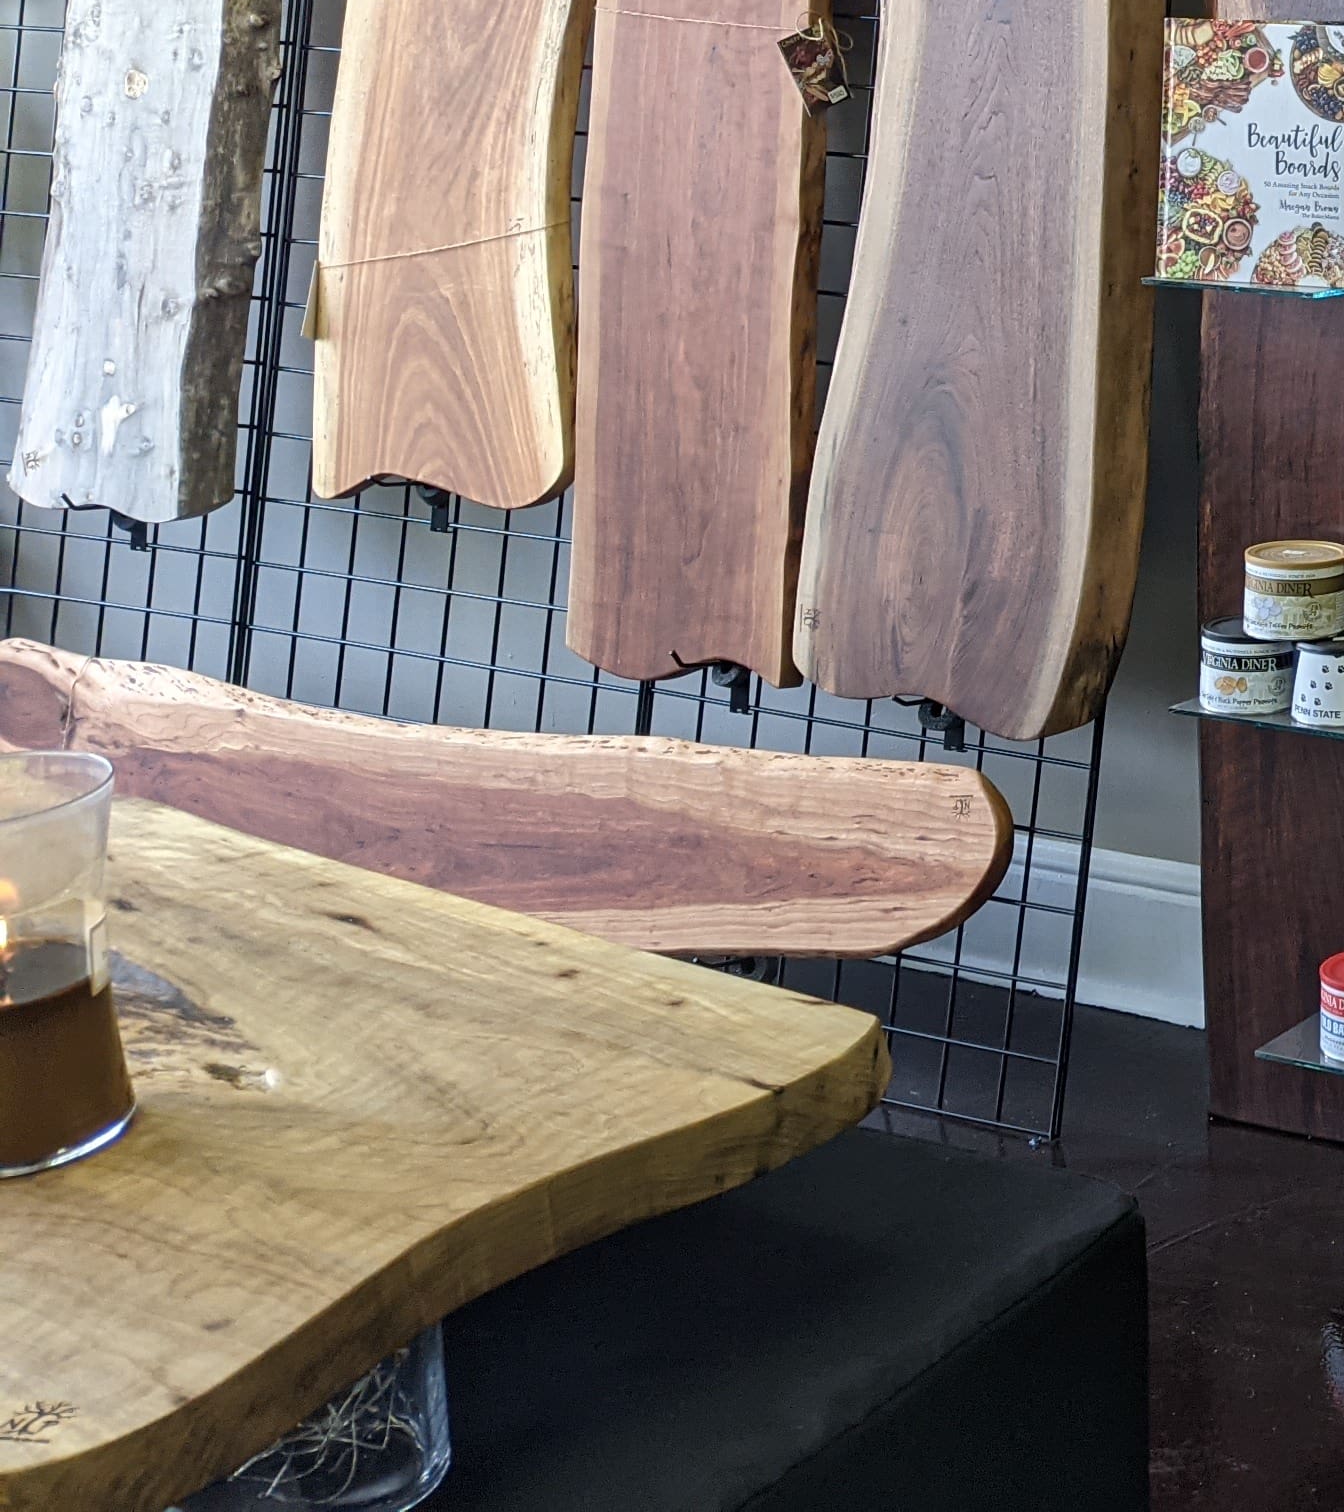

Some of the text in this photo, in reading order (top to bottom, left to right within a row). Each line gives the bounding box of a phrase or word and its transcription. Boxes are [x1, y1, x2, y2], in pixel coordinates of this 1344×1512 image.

[1247, 122, 1343, 158] Beautiful
[1275, 150, 1341, 182] Boards
[1241, 657, 1278, 672] DINER
[1312, 709, 1342, 719] STATE
